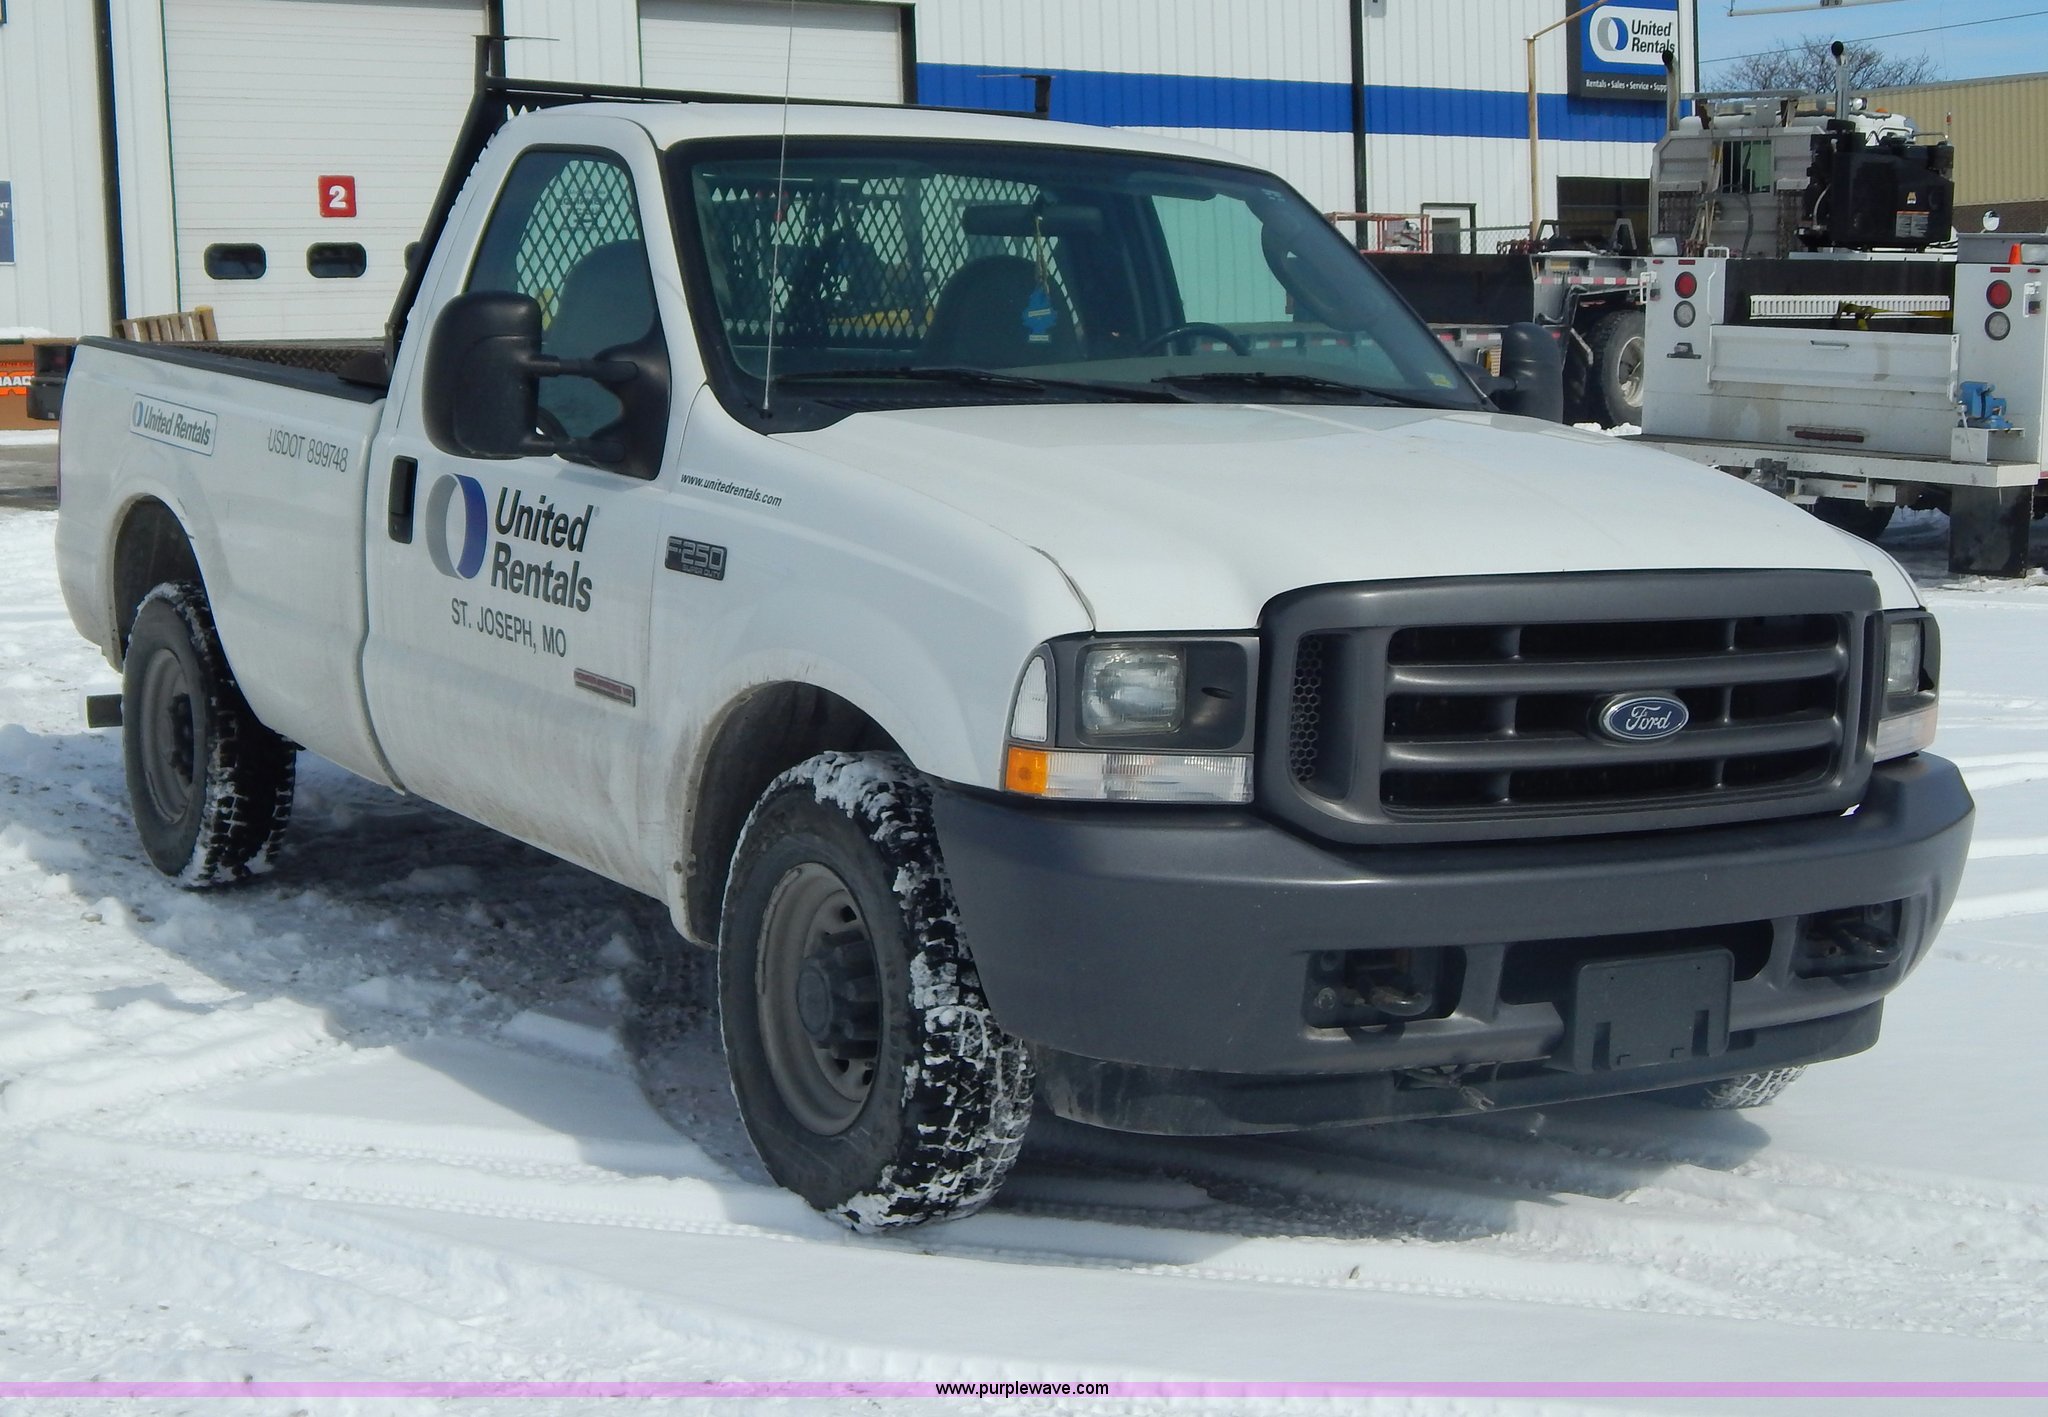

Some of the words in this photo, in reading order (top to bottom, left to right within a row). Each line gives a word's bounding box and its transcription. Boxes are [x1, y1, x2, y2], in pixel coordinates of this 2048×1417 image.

[1631, 19, 1673, 37] United
[1631, 37, 1675, 54] Rentals
[1585, 79, 1607, 88] Rentals
[1611, 80, 1626, 89] Sales
[1629, 81, 1650, 91] Service
[329, 185, 347, 208] 2
[143, 405, 173, 439] United
[173, 413, 211, 446] Rentals
[268, 428, 305, 460] USDOT
[307, 438, 349, 473] 899748
[680, 473, 782, 507] www.unitedrentals.com
[495, 486, 594, 553] United
[491, 541, 593, 612] Rentals
[451, 598, 472, 629] ST.
[477, 606, 537, 654] JOSEPH,
[542, 625, 567, 658] MO
[1625, 705, 1672, 731] Ford
